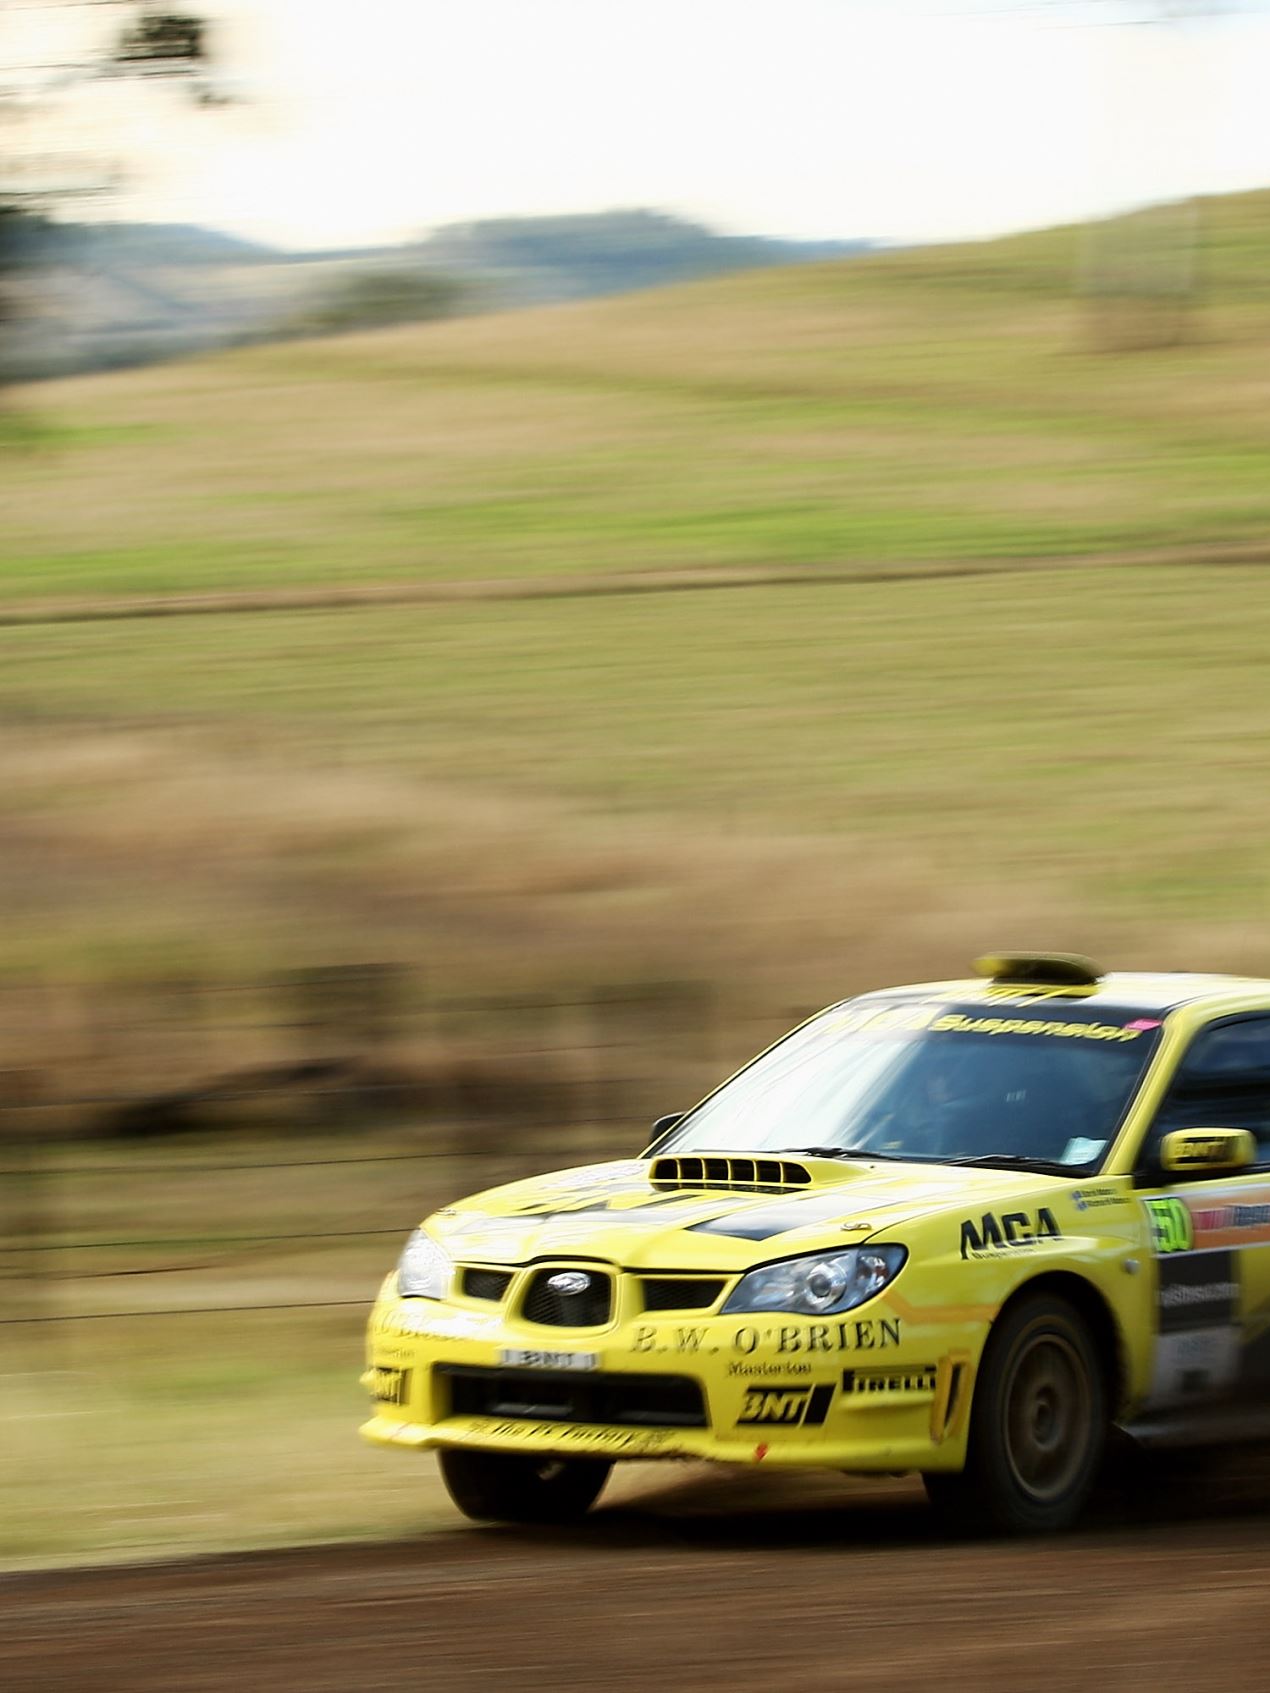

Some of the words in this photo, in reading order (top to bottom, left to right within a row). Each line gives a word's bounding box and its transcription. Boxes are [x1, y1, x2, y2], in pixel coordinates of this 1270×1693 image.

[928, 1014, 1143, 1043] Suspension
[960, 1207, 1062, 1260] MCA
[1152, 1200, 1191, 1252] 50
[733, 1317, 901, 1356] O'BRIEN
[853, 1365, 937, 1393] PIRELLI
[740, 1391, 810, 1420] BNT
